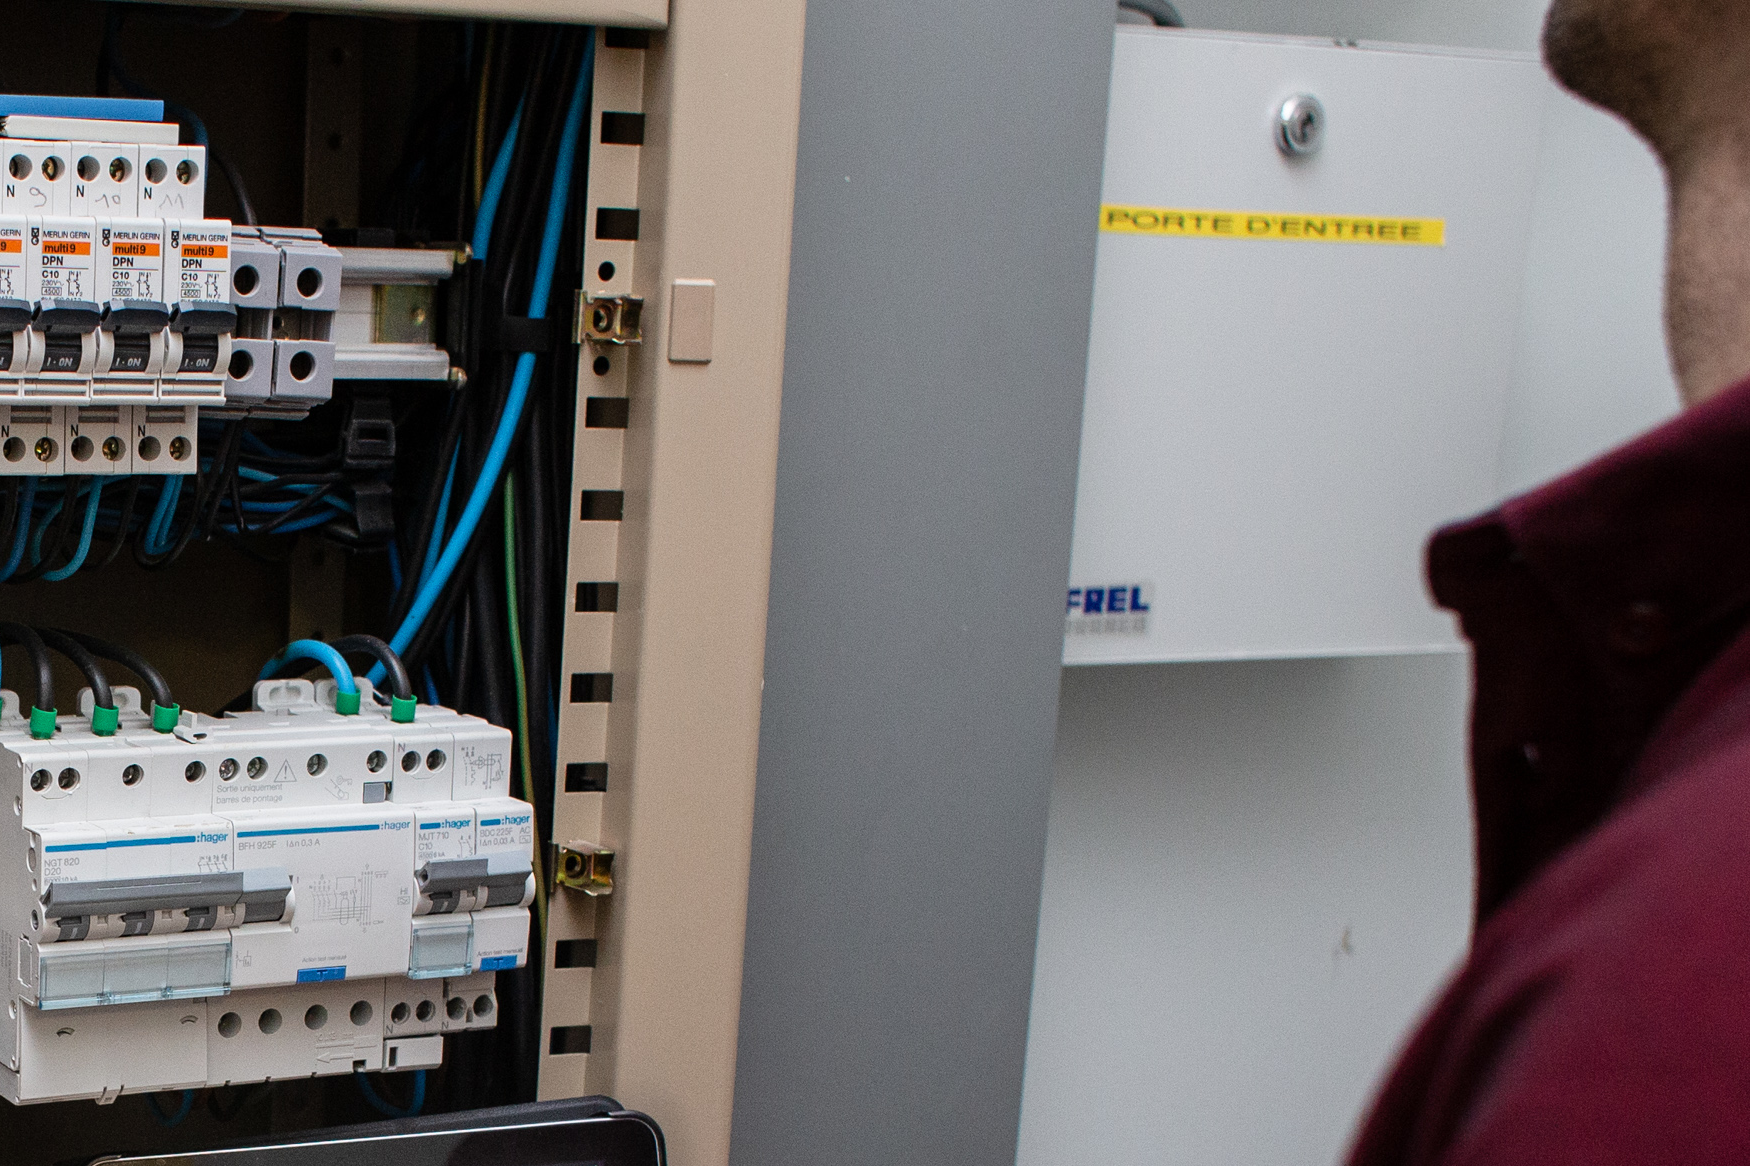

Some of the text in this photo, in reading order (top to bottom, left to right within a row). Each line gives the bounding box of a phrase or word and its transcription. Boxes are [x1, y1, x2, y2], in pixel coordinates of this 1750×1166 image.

[1107, 210, 1234, 233] PORTE
[181, 233, 228, 242] MERLIN GERIN
[42, 255, 63, 266] DPN
[181, 258, 202, 269] DPN
[181, 272, 198, 282] C10
[238, 842, 255, 851] BFH
[257, 840, 277, 850] 925F
[44, 857, 80, 868] NGT 820
